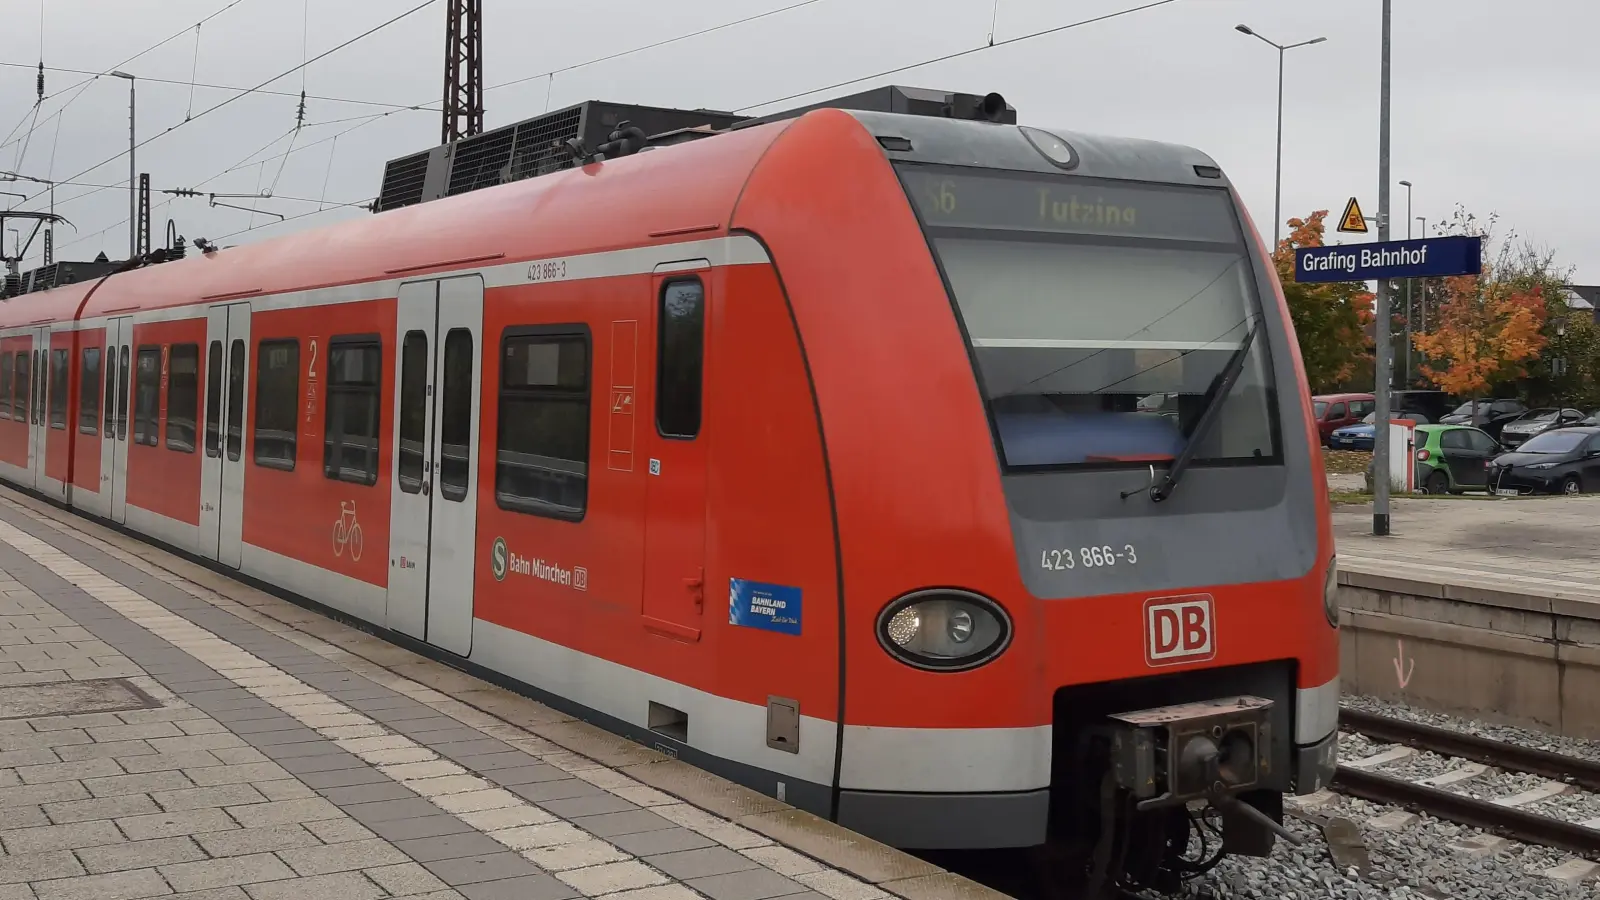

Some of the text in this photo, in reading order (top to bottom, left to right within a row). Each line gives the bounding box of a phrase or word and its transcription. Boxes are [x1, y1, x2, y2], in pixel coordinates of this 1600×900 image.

[1036, 187, 1137, 226] Tutzing
[528, 260, 566, 281] 423 866-3
[1303, 245, 1427, 273] Grafing Bahnhof
[162, 346, 169, 375] 2
[308, 340, 317, 377] 2
[493, 541, 506, 577] S
[510, 552, 530, 576] Bahn
[532, 558, 571, 586] München
[1041, 544, 1138, 571] 423 866-3
[750, 605, 776, 616] BAYERN
[751, 596, 787, 609] BAHNLAND
[1152, 604, 1209, 656] DB
